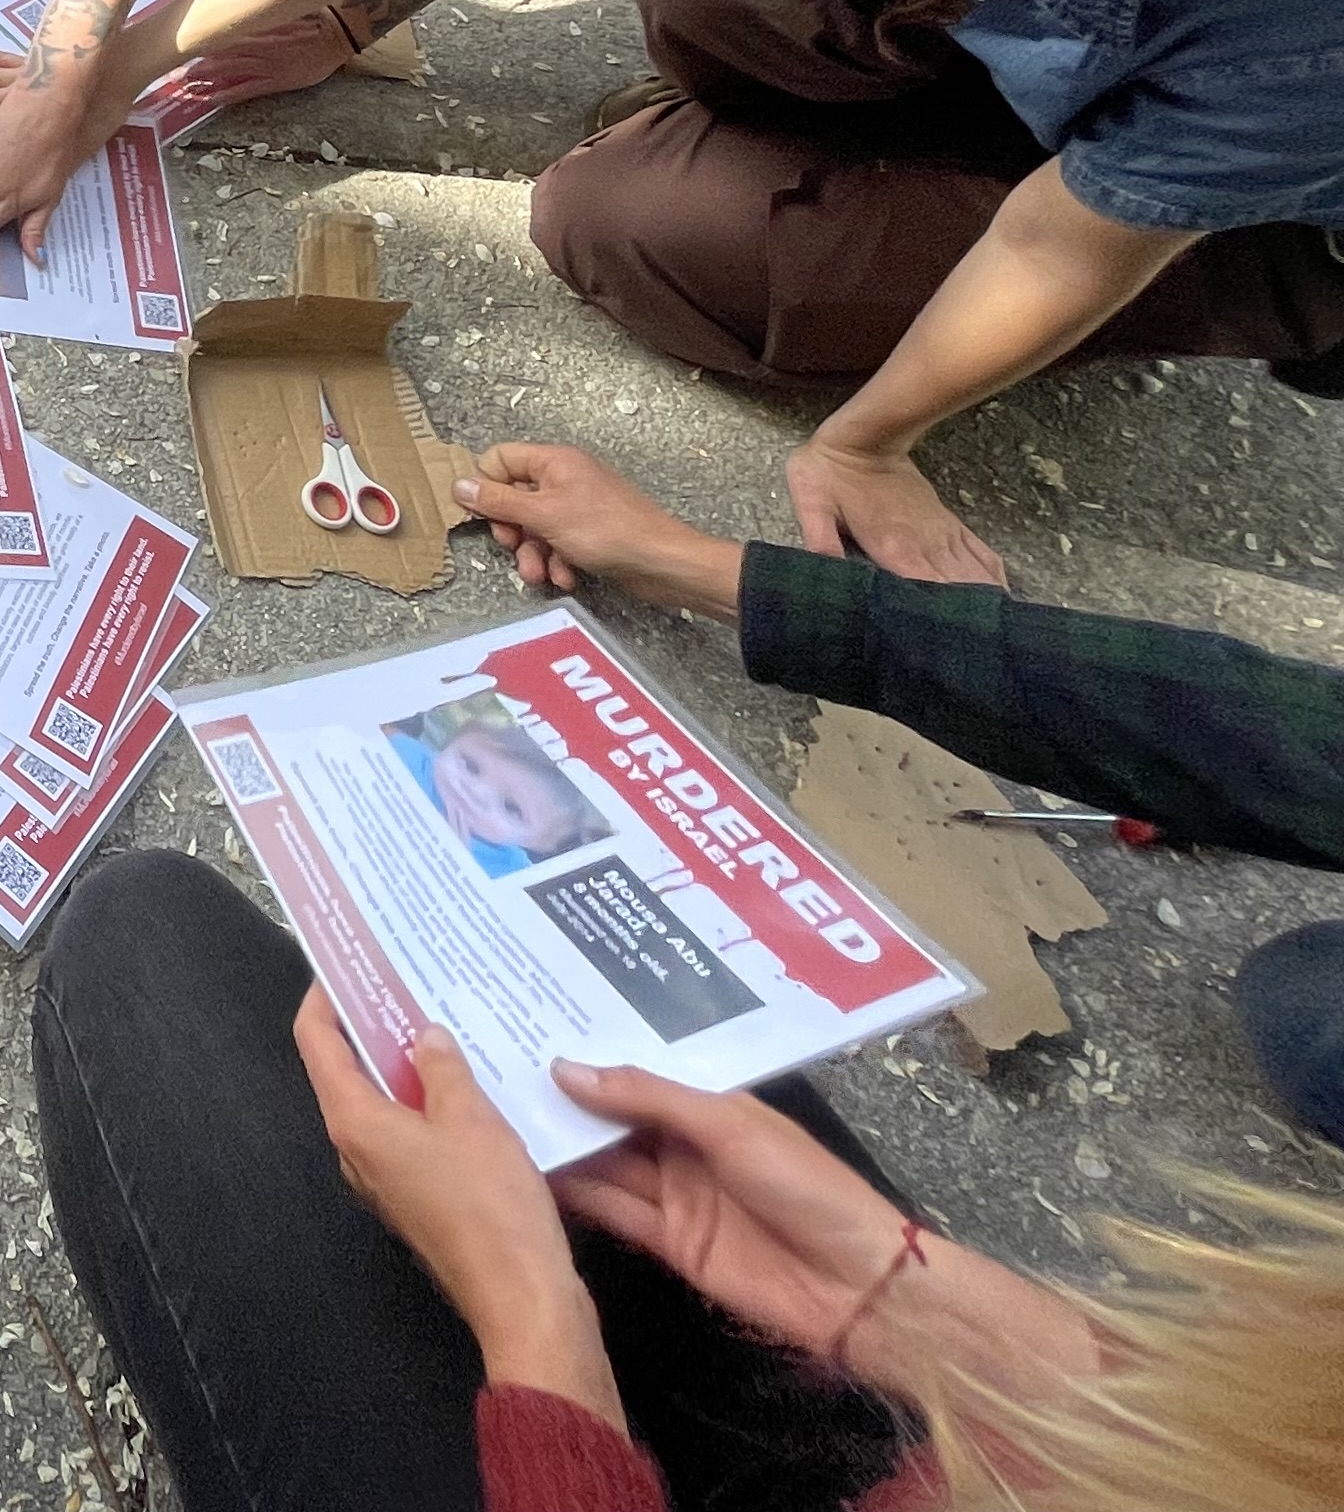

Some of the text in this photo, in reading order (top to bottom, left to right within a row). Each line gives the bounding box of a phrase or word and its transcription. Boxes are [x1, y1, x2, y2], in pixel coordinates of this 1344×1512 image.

[23, 671, 41, 697] Spread
[36, 660, 46, 673] the
[42, 643, 55, 661] truth.
[50, 615, 68, 642] Change
[64, 604, 73, 615] the
[70, 574, 89, 604] narrative.
[84, 557, 97, 572] Take
[65, 538, 148, 699] Palestinians have every right to their land.
[79, 551, 155, 698] Palestinians have every right to resist.
[550, 655, 881, 963] MURDERED
[608, 749, 737, 880] BY ISRAEL
[584, 894, 639, 950] months
[589, 877, 648, 936] Jarad,
[604, 870, 711, 977] Mousa Abu
